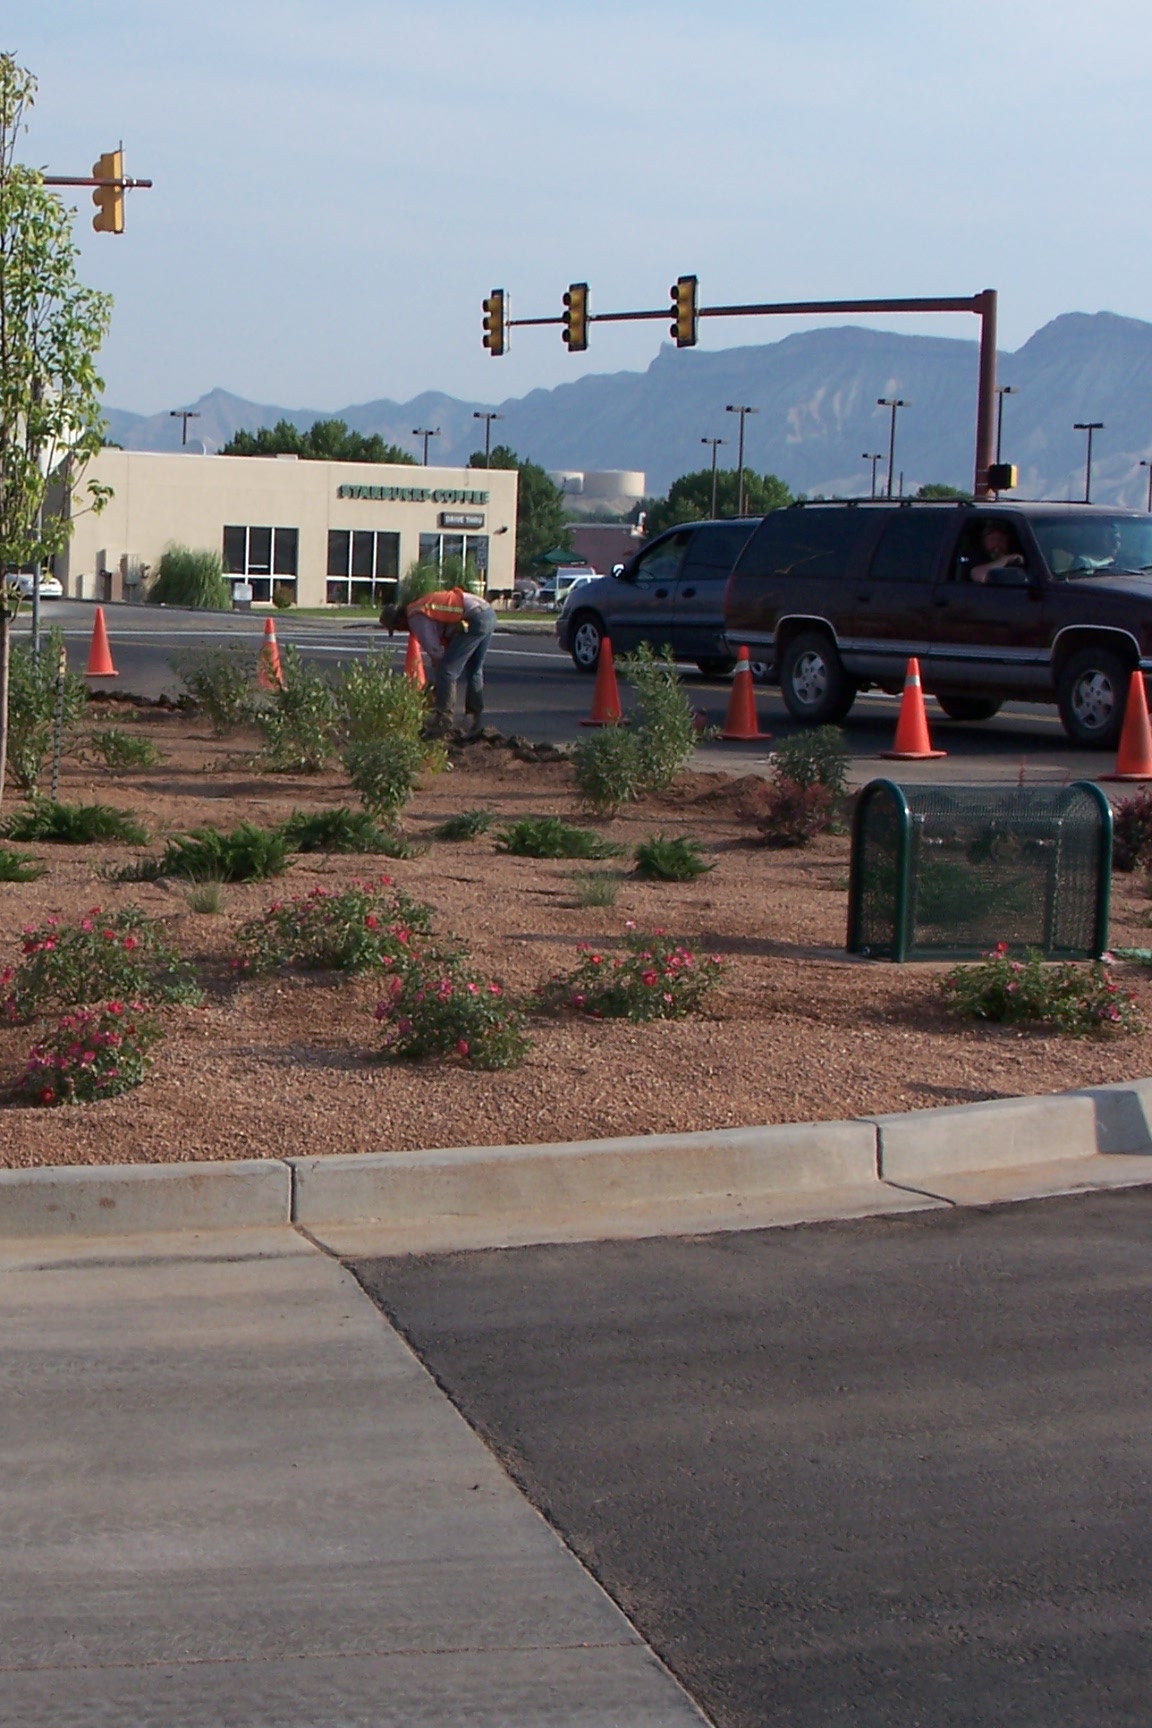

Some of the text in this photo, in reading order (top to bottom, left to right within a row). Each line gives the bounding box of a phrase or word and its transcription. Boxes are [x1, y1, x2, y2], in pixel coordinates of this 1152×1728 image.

[338, 484, 490, 505] STARBUCKS COFFEE
[445, 514, 464, 525] DRIVE
